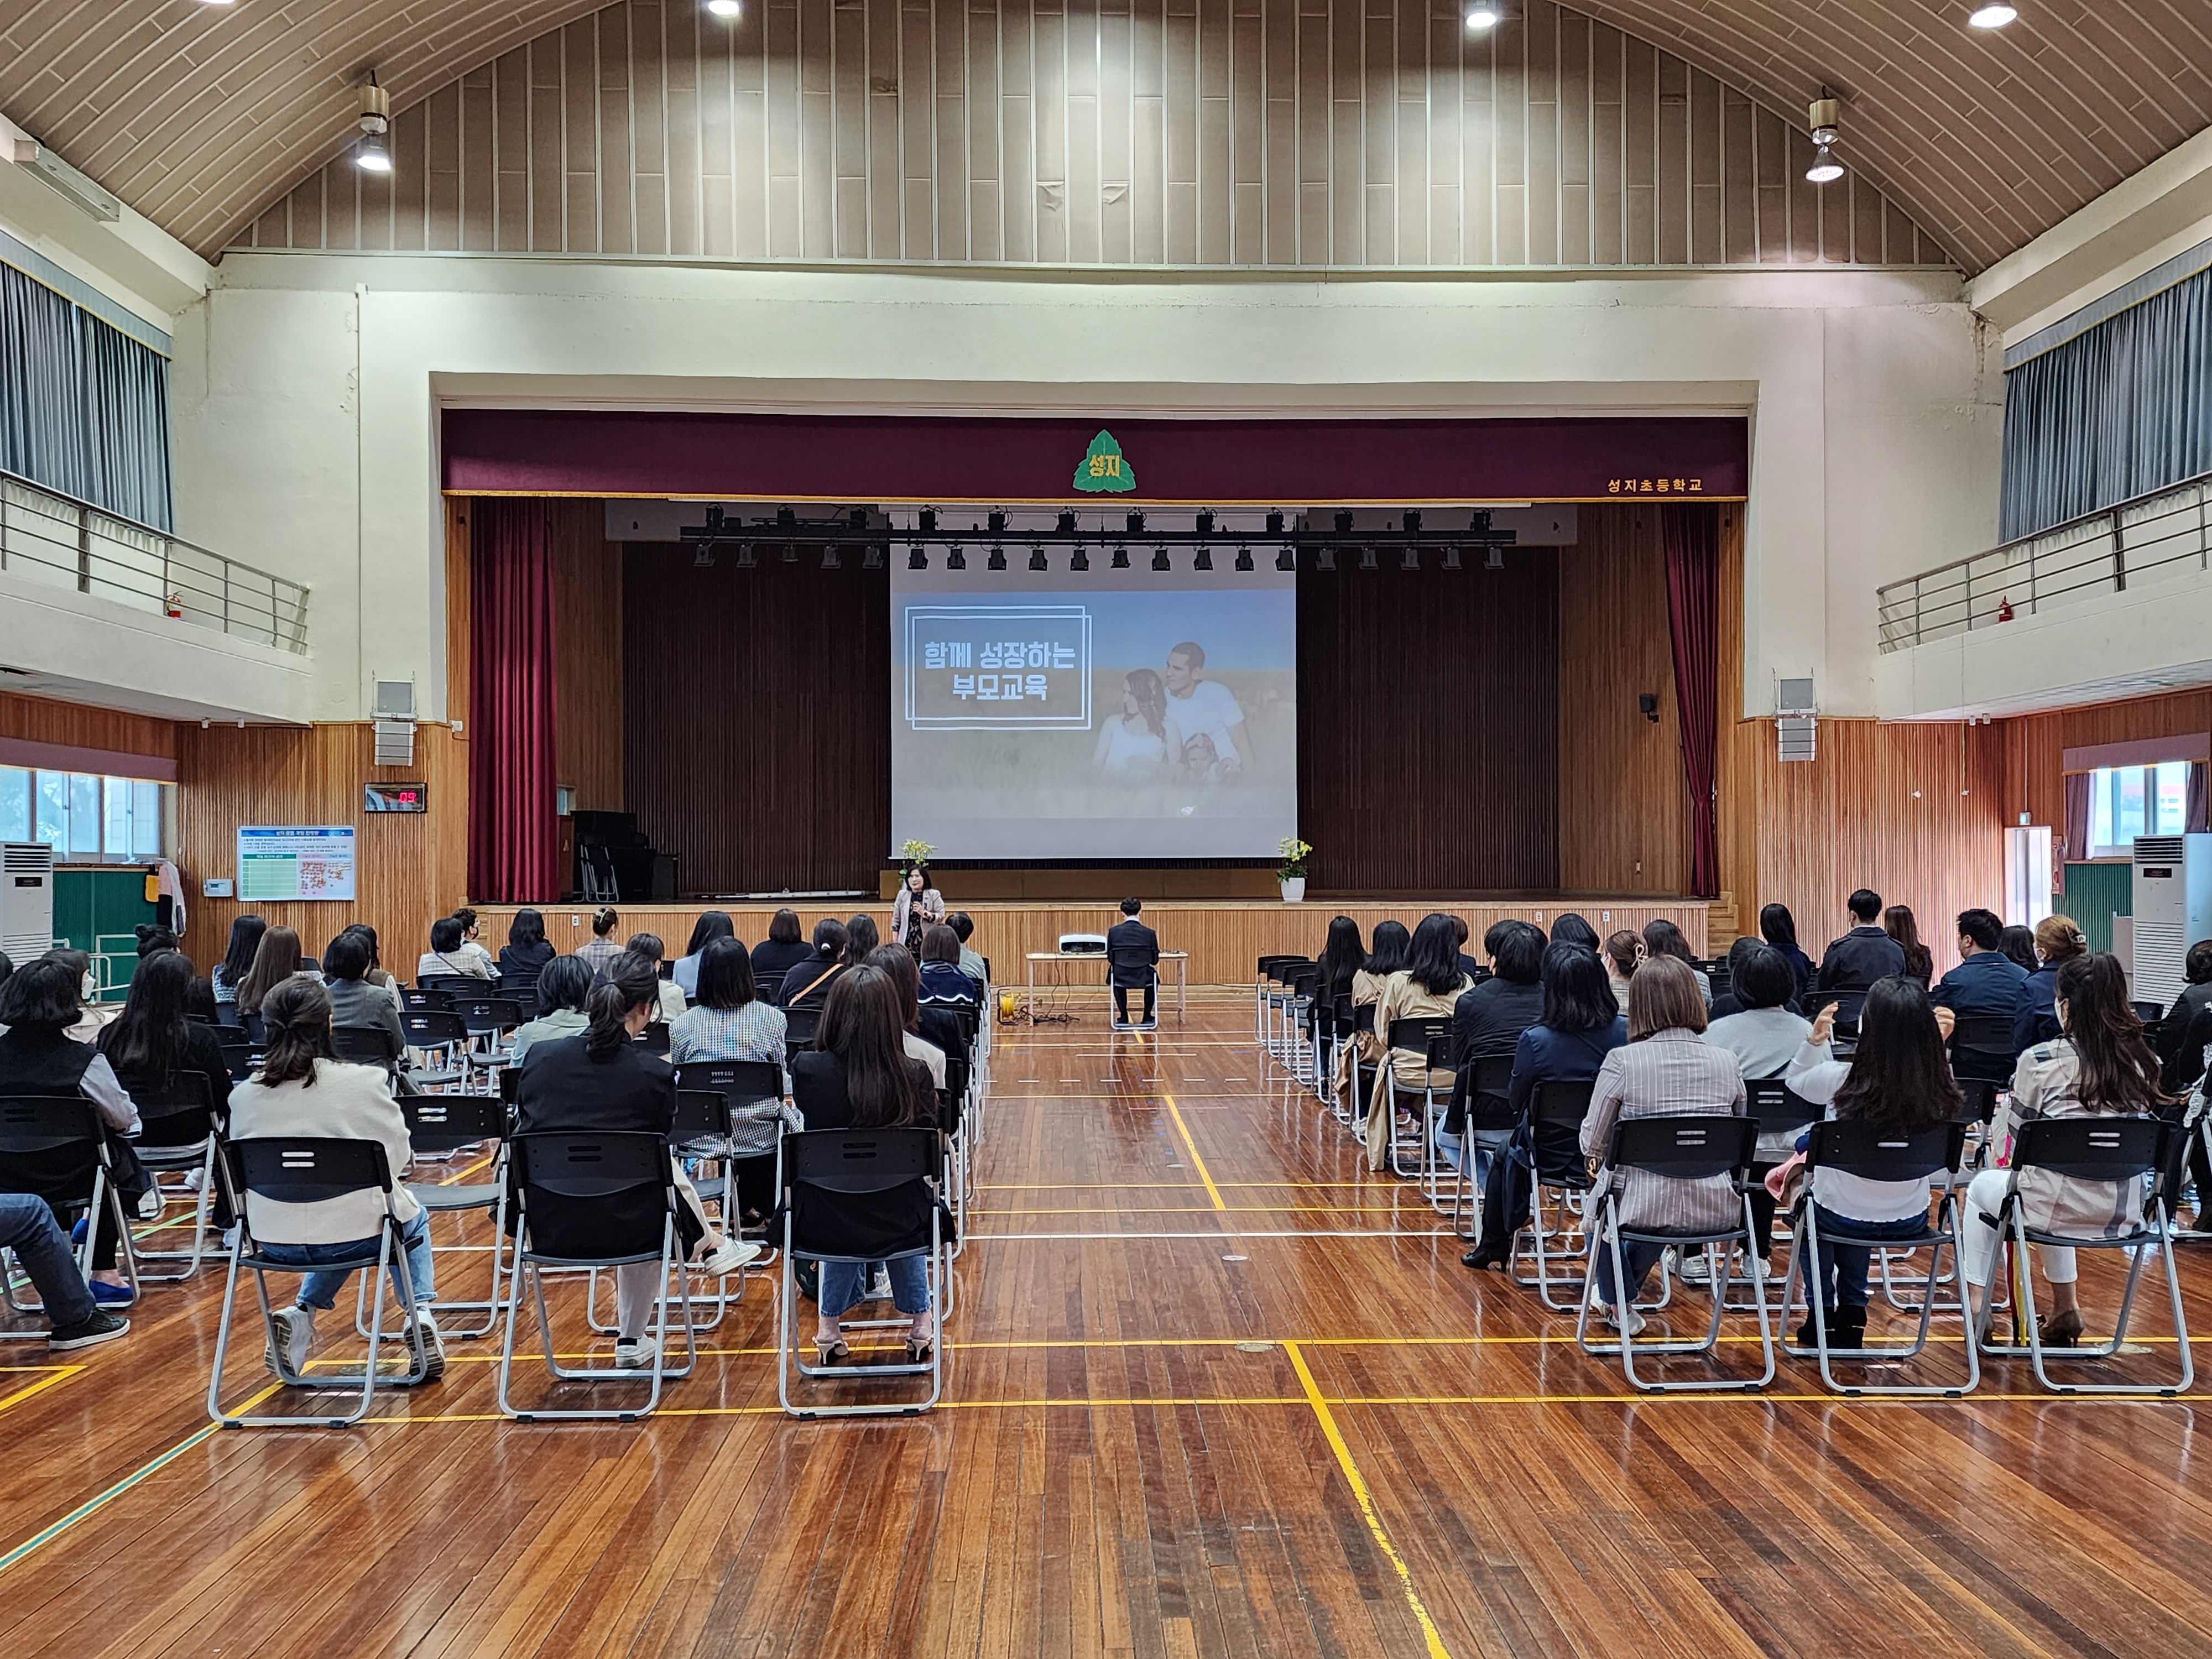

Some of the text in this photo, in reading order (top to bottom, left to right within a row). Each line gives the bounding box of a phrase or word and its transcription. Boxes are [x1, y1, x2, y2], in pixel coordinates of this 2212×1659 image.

[1089, 455, 1120, 477] 성지
[1608, 478, 1702, 493] 성지초등학교
[925, 641, 1075, 669] 함께 성장하는
[952, 674, 1047, 701] 부모교육
